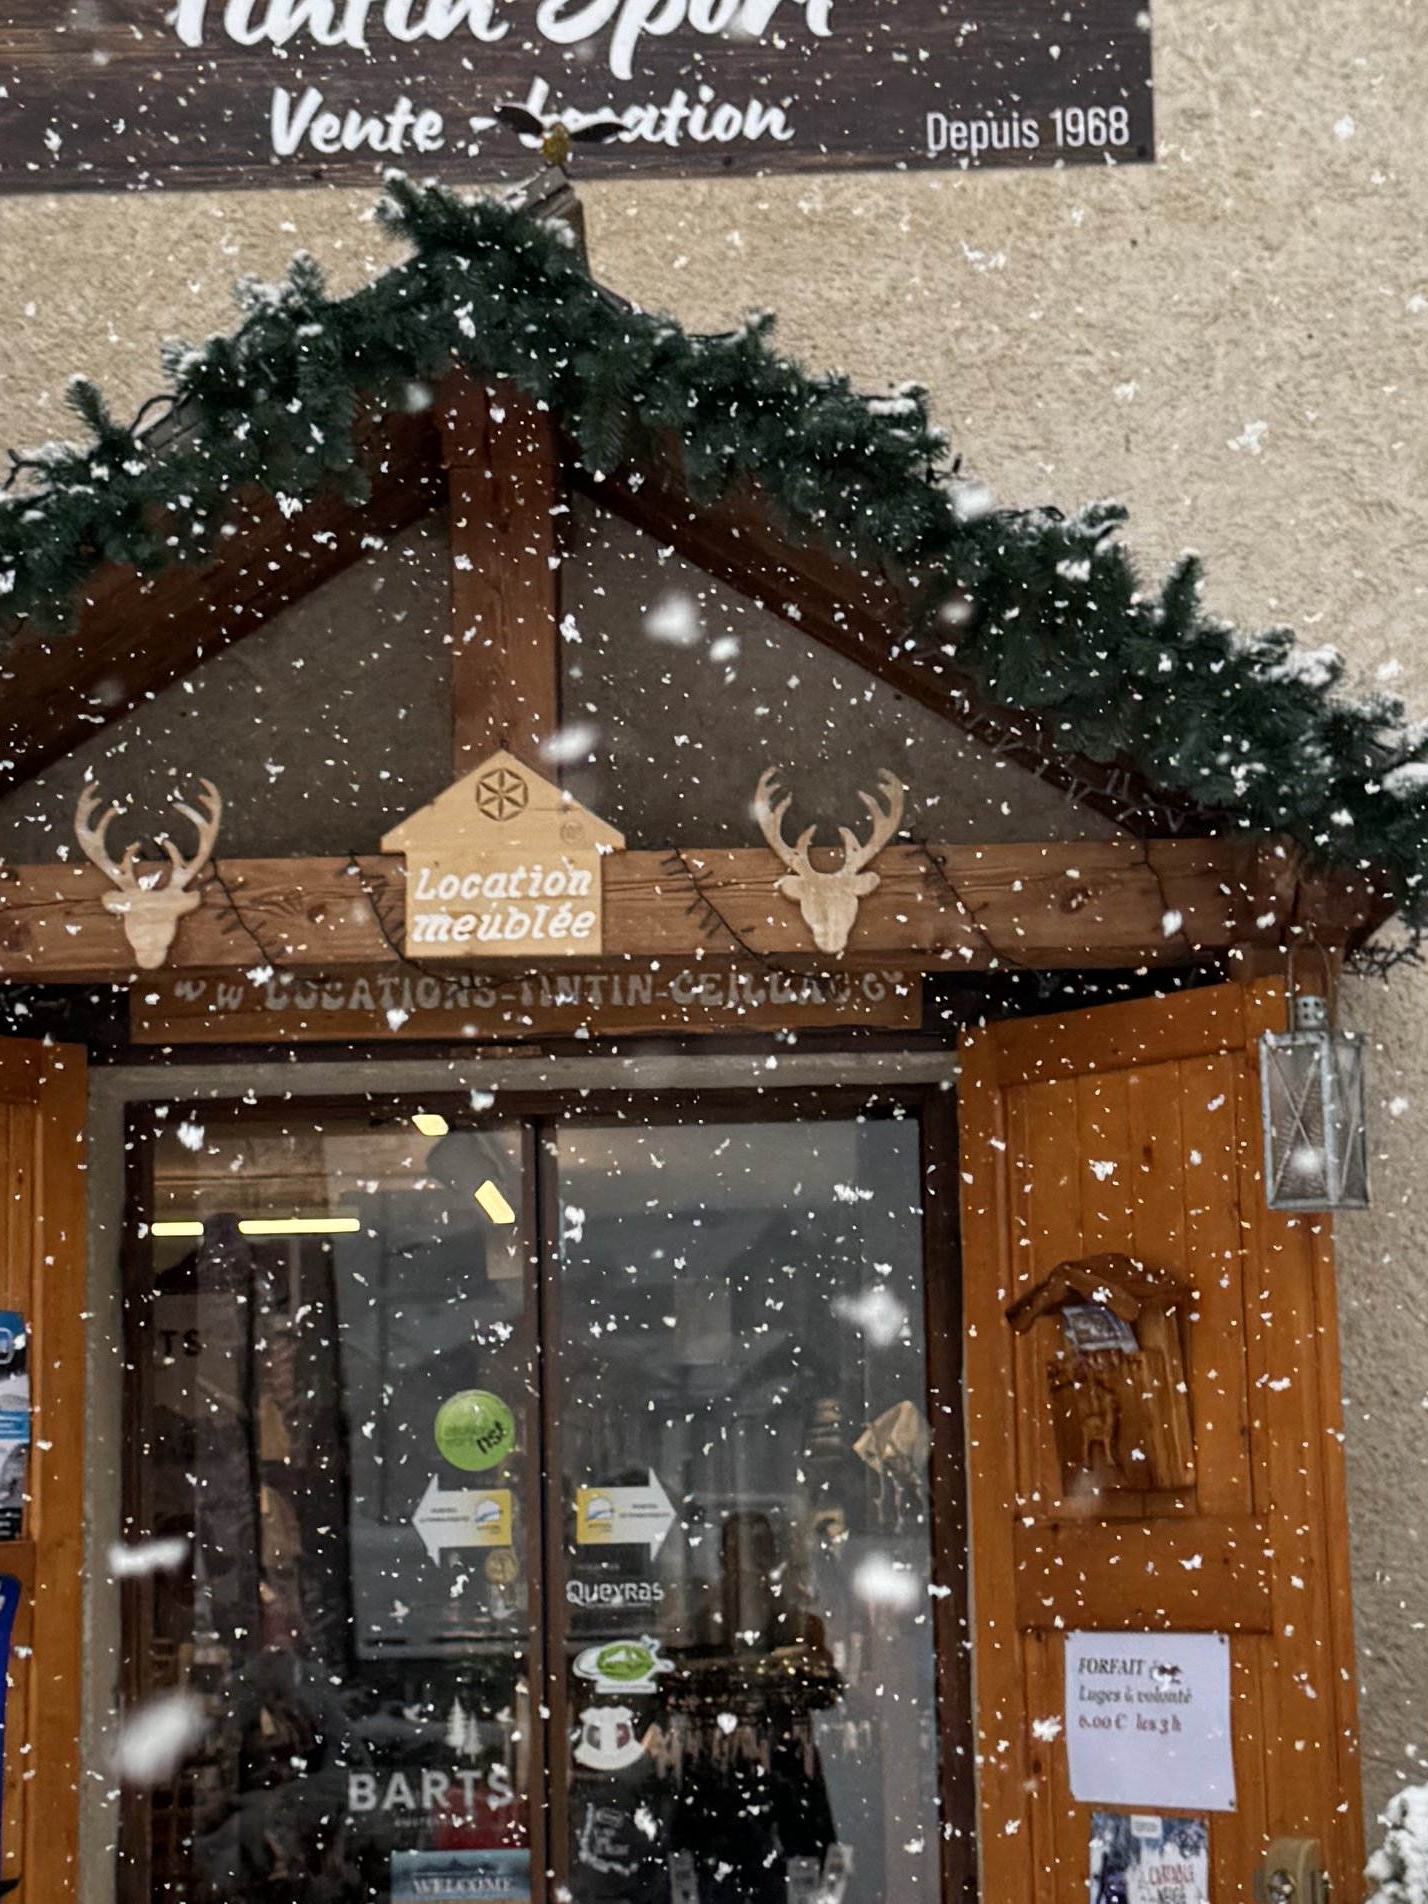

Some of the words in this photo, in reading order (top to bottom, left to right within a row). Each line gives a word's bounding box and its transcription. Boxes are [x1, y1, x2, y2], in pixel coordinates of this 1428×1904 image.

[271, 86, 444, 157] Vente
[925, 109, 1043, 154] Depuis
[1053, 104, 1132, 151] 1968
[414, 861, 592, 902] Location
[411, 901, 597, 944] meublée
[1078, 1657, 1146, 1676] FORFAIT
[1079, 1684, 1121, 1706] Luges
[1136, 1685, 1193, 1704] volonté
[1136, 1713, 1157, 1731] les
[347, 1768, 516, 1812] BARTS
[412, 1876, 516, 1895] WELCOME
